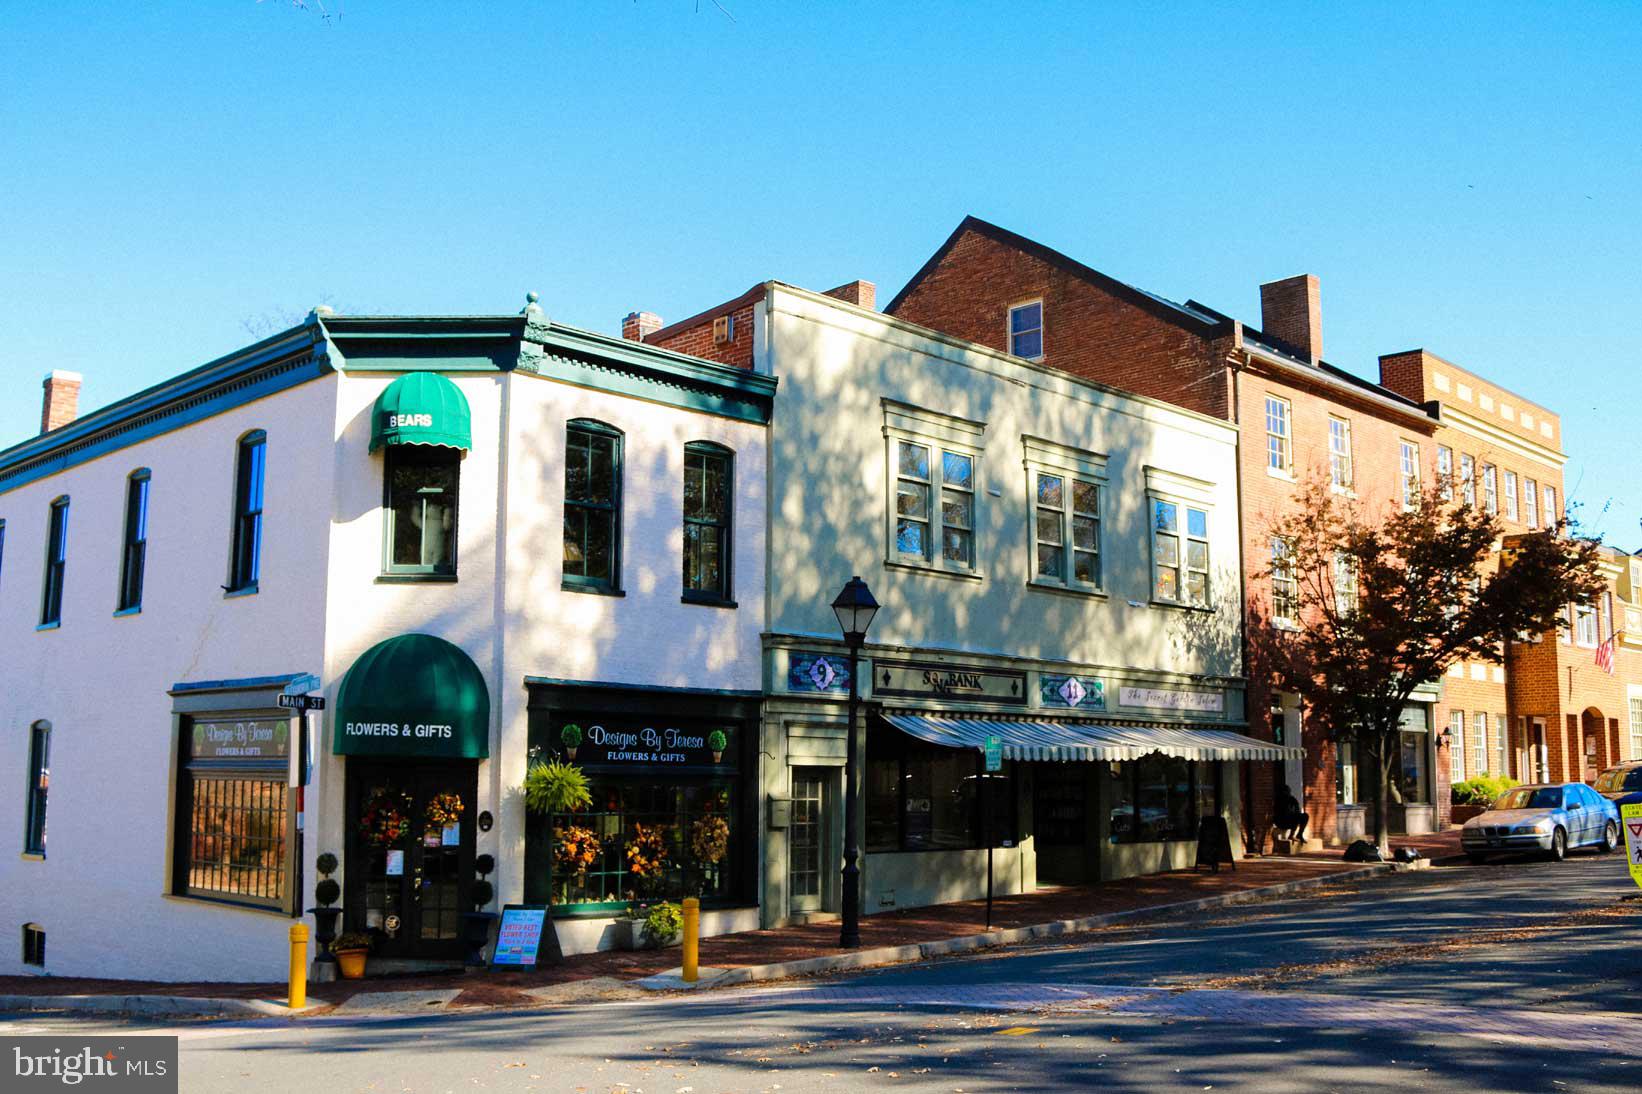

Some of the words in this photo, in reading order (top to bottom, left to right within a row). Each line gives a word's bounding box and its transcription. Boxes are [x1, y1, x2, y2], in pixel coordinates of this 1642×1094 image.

[389, 413, 433, 428] BEARS
[816, 663, 827, 683] 9
[1067, 681, 1079, 700] 11
[281, 695, 305, 709] MAIN
[310, 697, 323, 709] ST
[346, 722, 399, 737] FLOWERS
[402, 723, 411, 737] &
[414, 724, 452, 738] GIFTS
[587, 725, 638, 751] Designs
[639, 727, 662, 752] By
[663, 728, 704, 749] Teresa
[607, 751, 649, 761] FLOWERS
[650, 752, 658, 761] &
[660, 753, 686, 762] GIFTS
